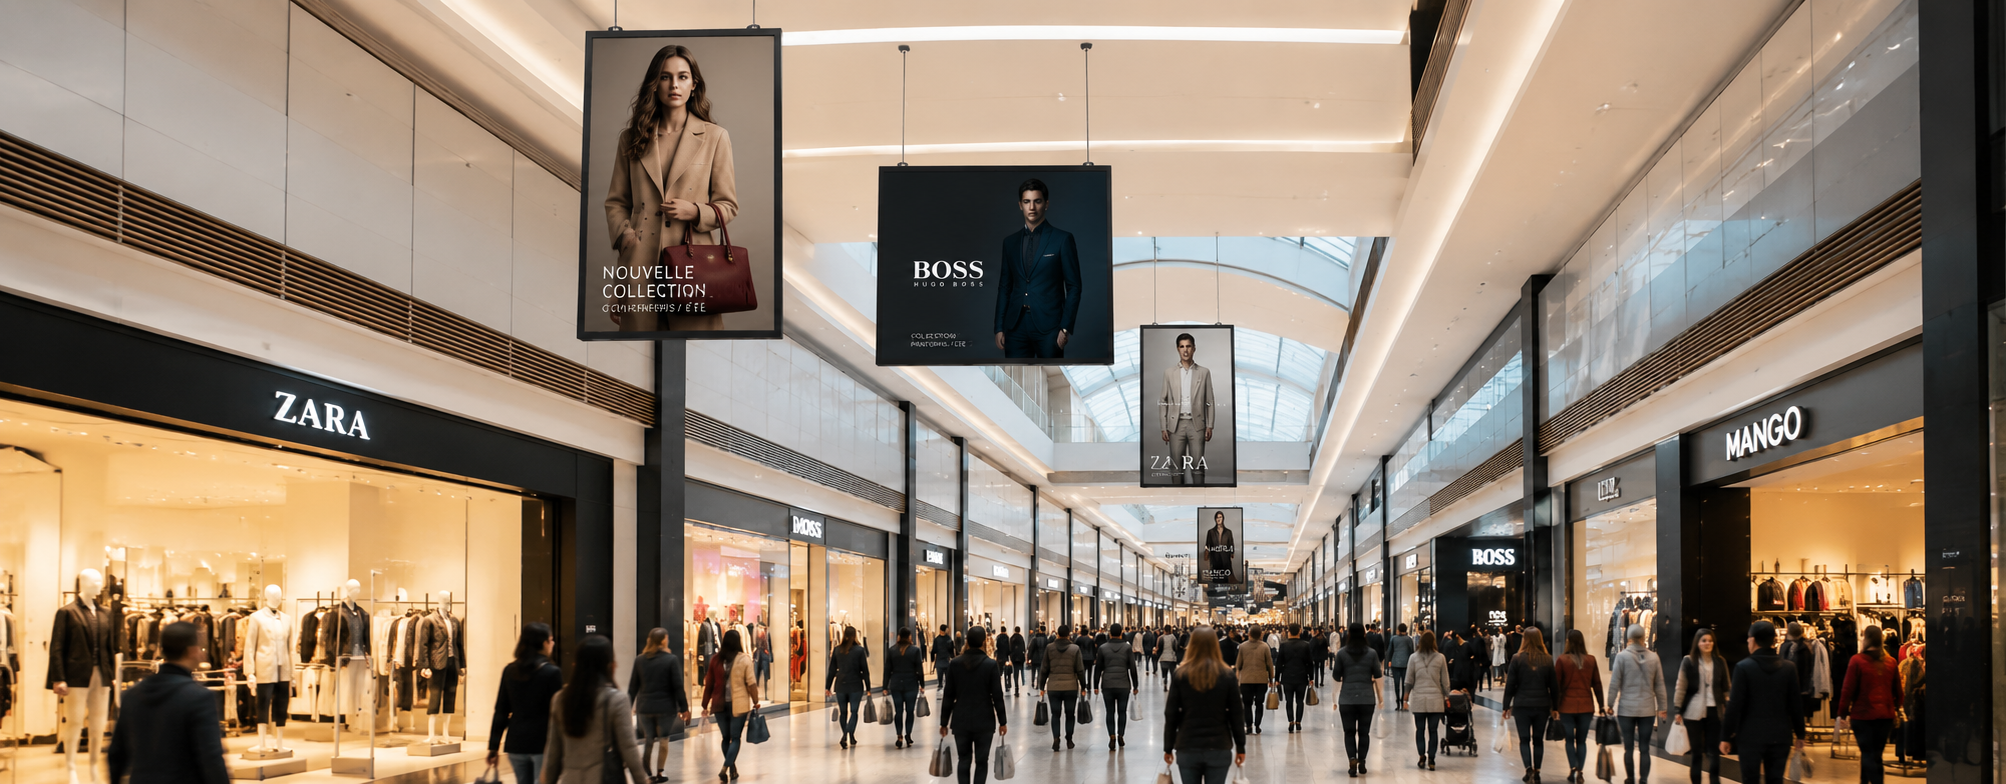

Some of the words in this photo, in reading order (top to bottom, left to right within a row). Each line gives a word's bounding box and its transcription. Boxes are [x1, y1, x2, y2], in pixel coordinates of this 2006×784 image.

[603, 265, 694, 280] NOUVELLE
[913, 260, 984, 280] BOSS
[602, 283, 706, 299] COLLECTION
[273, 390, 371, 441] ZARA
[1726, 405, 1802, 461] MANGO
[1471, 548, 1516, 566] BOSS
